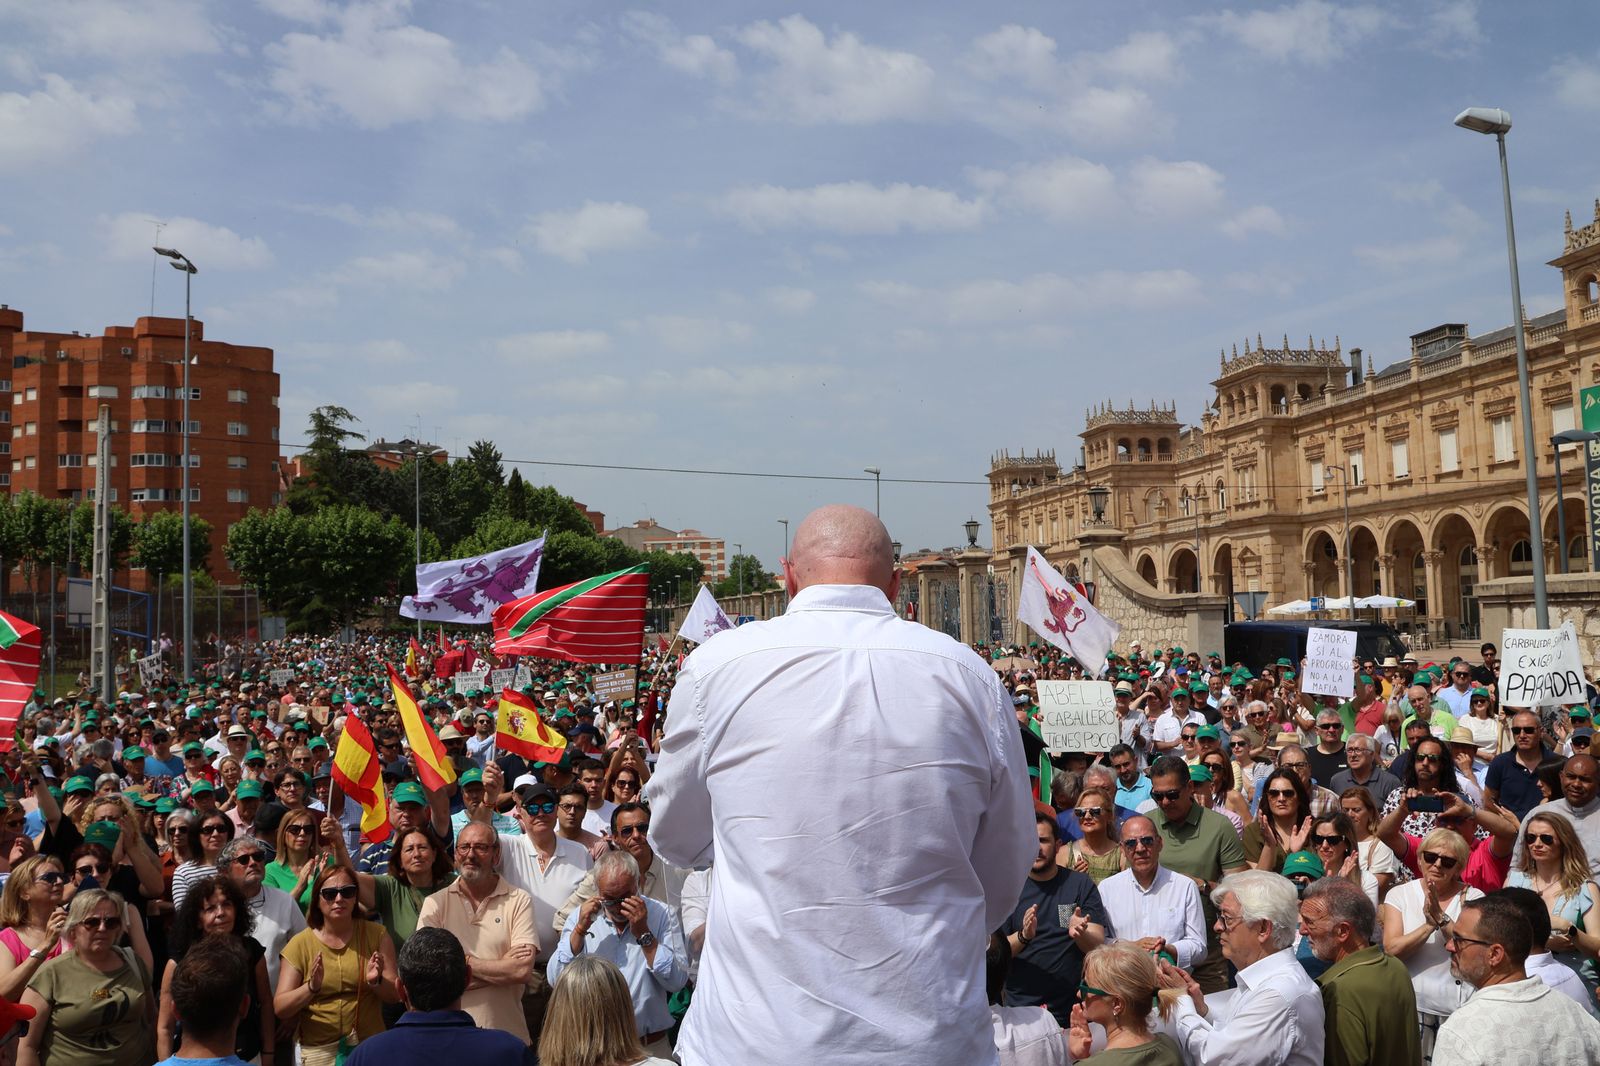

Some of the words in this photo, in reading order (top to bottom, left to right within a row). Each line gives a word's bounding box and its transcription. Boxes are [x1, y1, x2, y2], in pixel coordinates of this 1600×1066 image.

[1329, 647, 1342, 657] AL
[1311, 659, 1350, 670] PROGRESO
[1310, 672, 1320, 680] NO
[1323, 673, 1328, 681] A
[1332, 675, 1343, 683] LA
[1505, 670, 1582, 701] PARADA
[1042, 684, 1092, 705] ABEL
[1097, 686, 1113, 707] de
[1046, 710, 1115, 727] CABALLERO
[1044, 731, 1080, 749] TIENES
[1084, 731, 1118, 748] POCO
